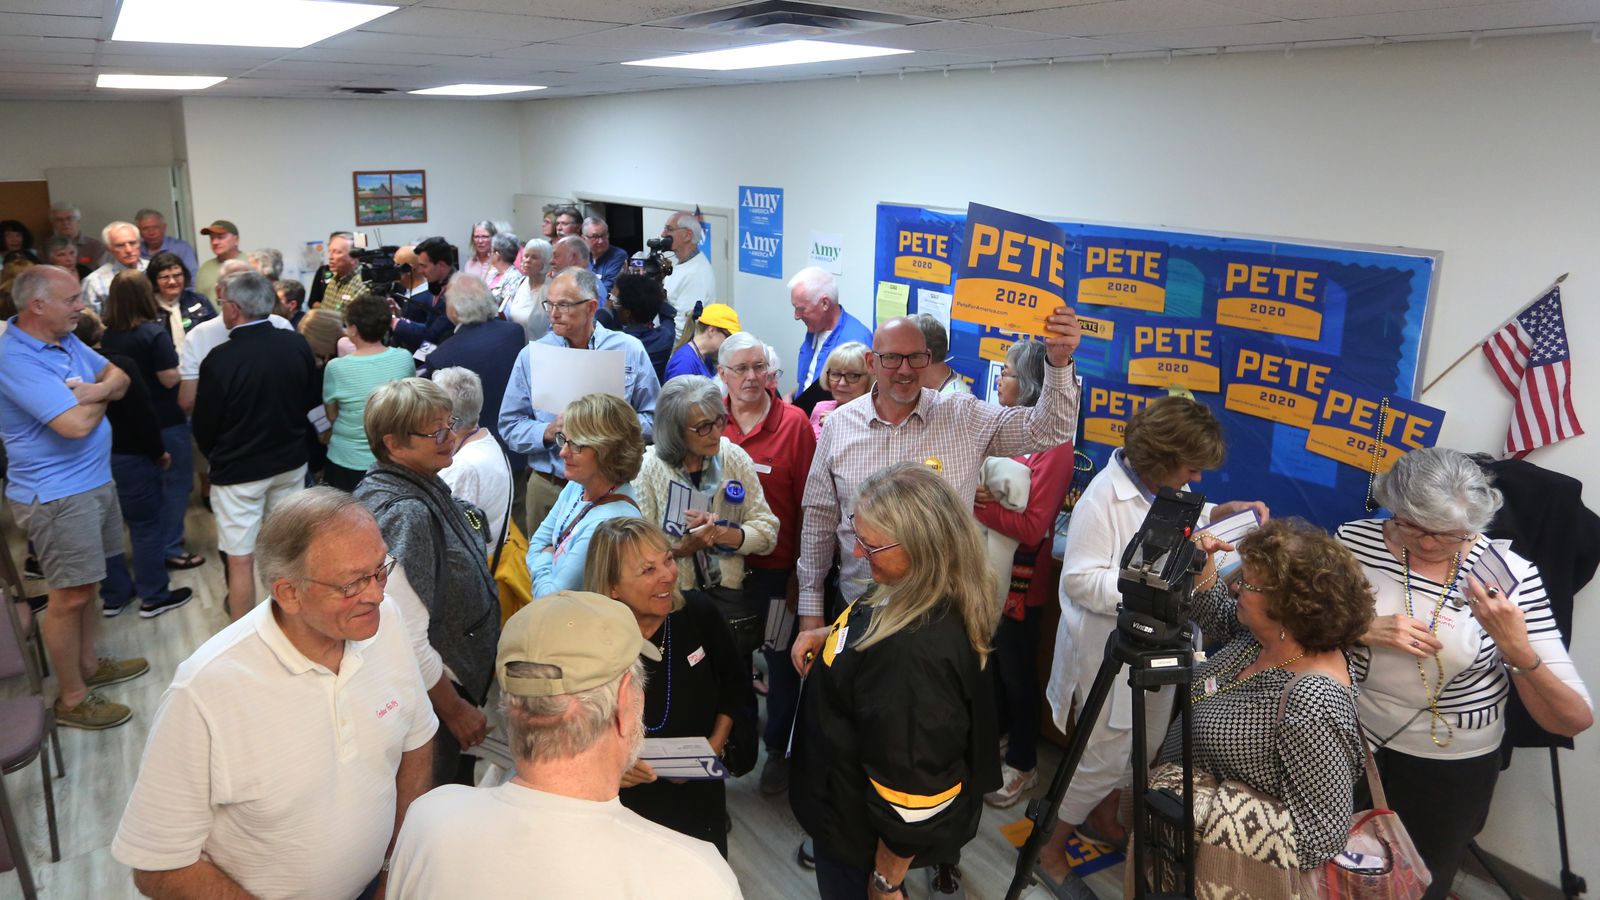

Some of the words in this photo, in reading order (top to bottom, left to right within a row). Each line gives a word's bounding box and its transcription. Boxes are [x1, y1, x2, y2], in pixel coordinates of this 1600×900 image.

[742, 189, 780, 213] Amy
[741, 231, 780, 257] Amy
[811, 242, 841, 260] Amy
[899, 230, 949, 258] PETE
[912, 259, 933, 269] 2020
[968, 223, 1064, 288] PETE
[1086, 246, 1162, 279] PETE
[1108, 282, 1137, 293] 2020
[1225, 262, 1319, 303] PETE
[995, 287, 1038, 308] 2020
[956, 301, 1009, 316] PeteForAmerica.com
[1250, 303, 1286, 317] 2020
[1078, 320, 1098, 332] PETE
[1135, 326, 1213, 358] PETE
[1158, 362, 1189, 373] 2020
[1236, 348, 1332, 395] PETE
[1259, 391, 1296, 408] 2020
[1322, 389, 1433, 449] PETE
[1346, 436, 1388, 458] 2020
[699, 757, 723, 777] 2
